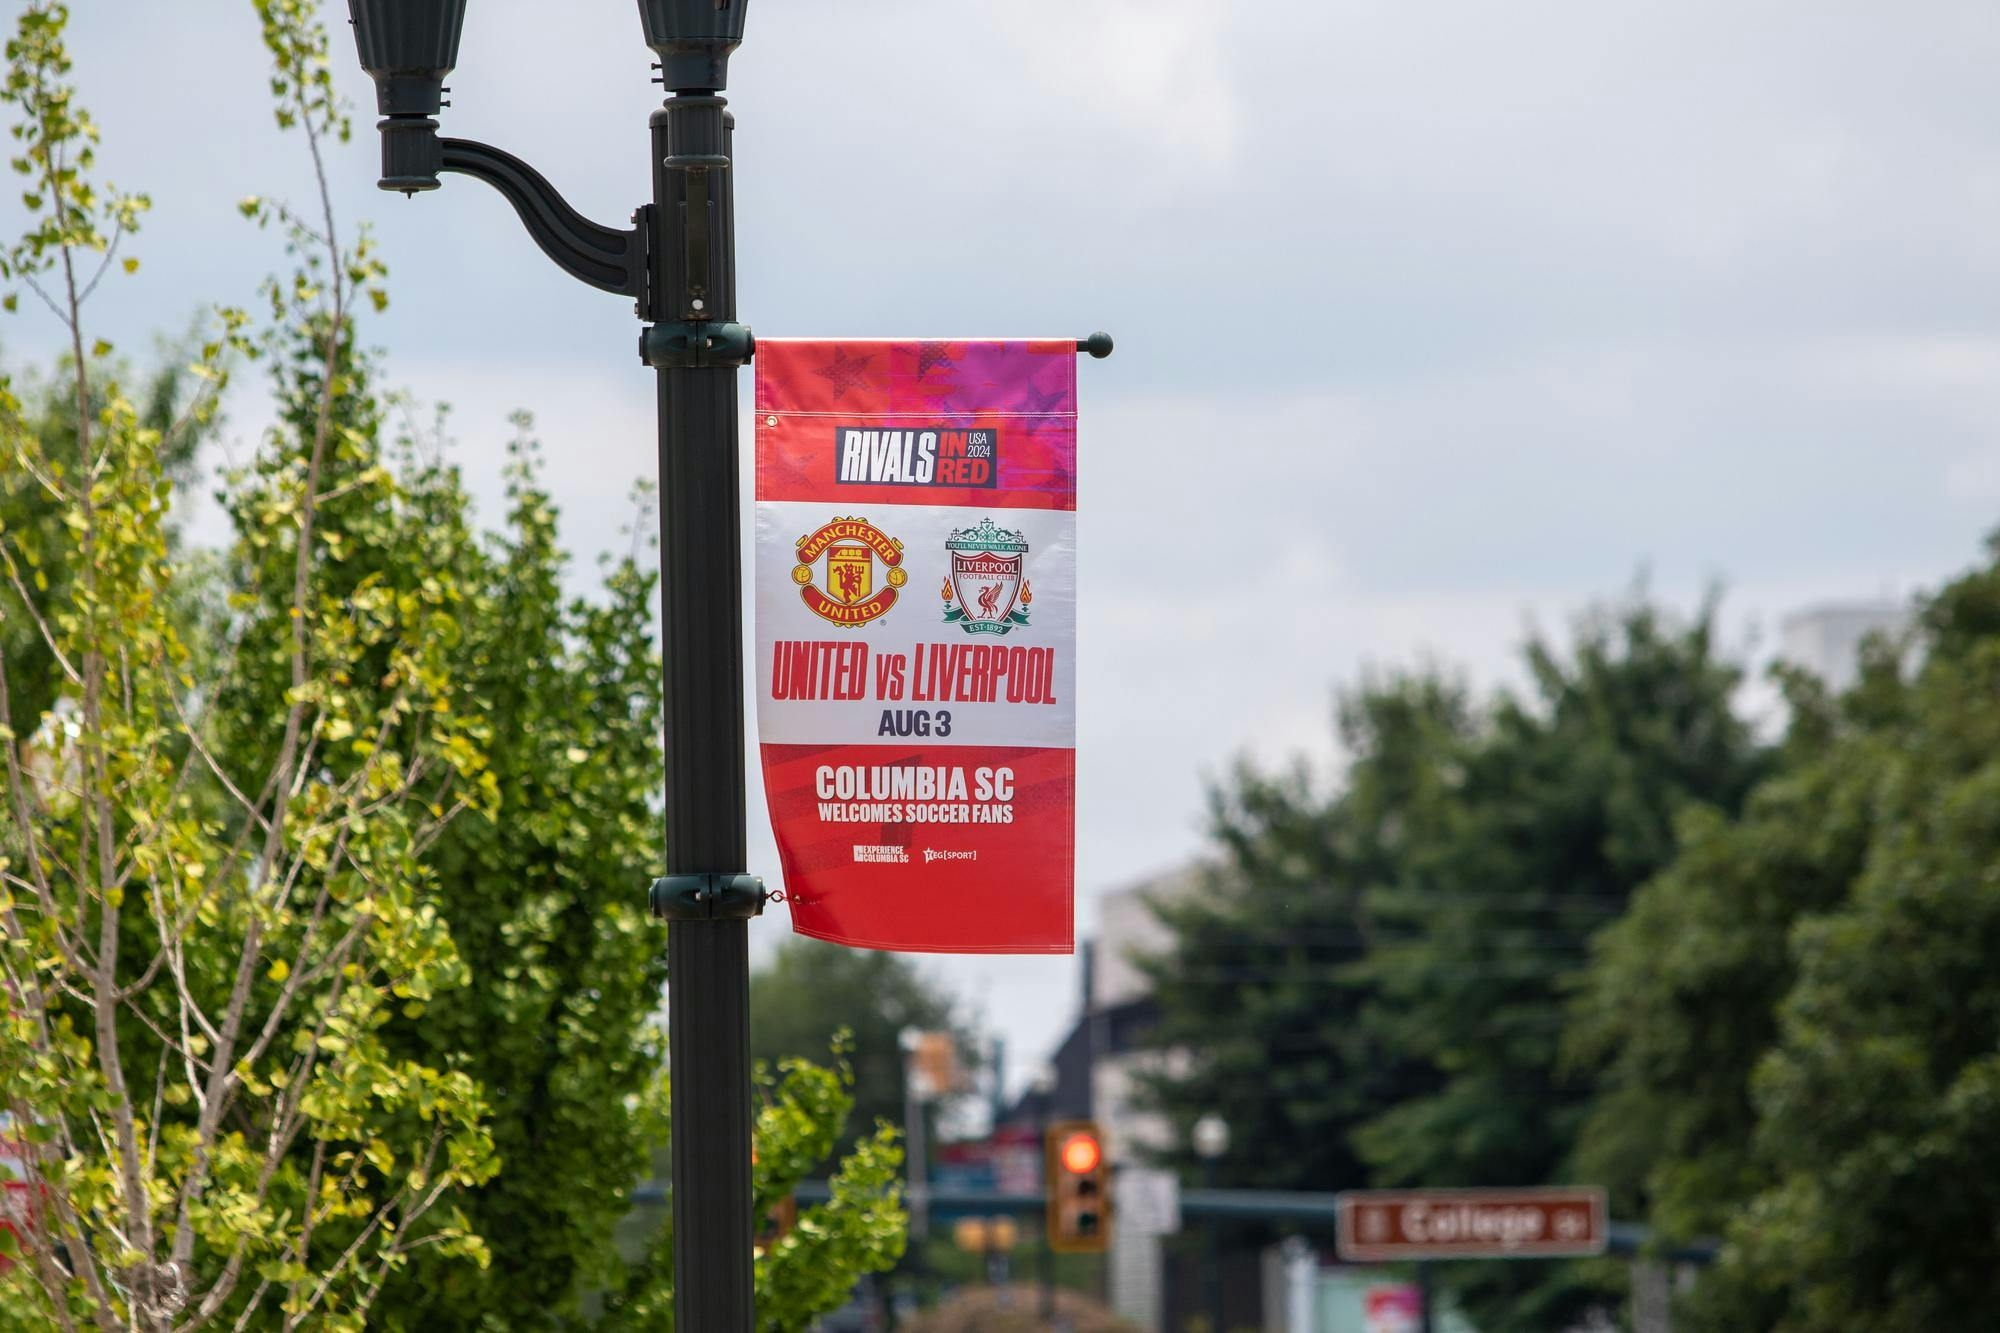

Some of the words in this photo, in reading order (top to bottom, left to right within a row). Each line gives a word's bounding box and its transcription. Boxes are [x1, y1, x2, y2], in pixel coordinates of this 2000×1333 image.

[969, 432, 986, 444] USA
[841, 430, 936, 483] RIVALS
[939, 431, 967, 457] IN
[968, 445, 990, 458] 2024
[936, 458, 990, 485] RED
[804, 525, 895, 561] MANCHESTER
[947, 542, 966, 550] YOU'LL
[957, 561, 1017, 573] LIVERPOOL
[819, 600, 881, 619] UNITED
[771, 641, 869, 701] UNITED
[912, 643, 1056, 704] LIVERPOOL
[878, 709, 930, 736] AUG
[935, 710, 951, 737] 3
[815, 765, 969, 801] COLUMBIA
[974, 767, 1014, 802] SC
[818, 802, 902, 823] WELCOMES
[905, 803, 970, 824] SOCCER
[972, 804, 1014, 824] FANS
[863, 845, 904, 855] EXPERIENCE
[863, 854, 899, 863] COLUMBIA
[899, 854, 909, 863] SC
